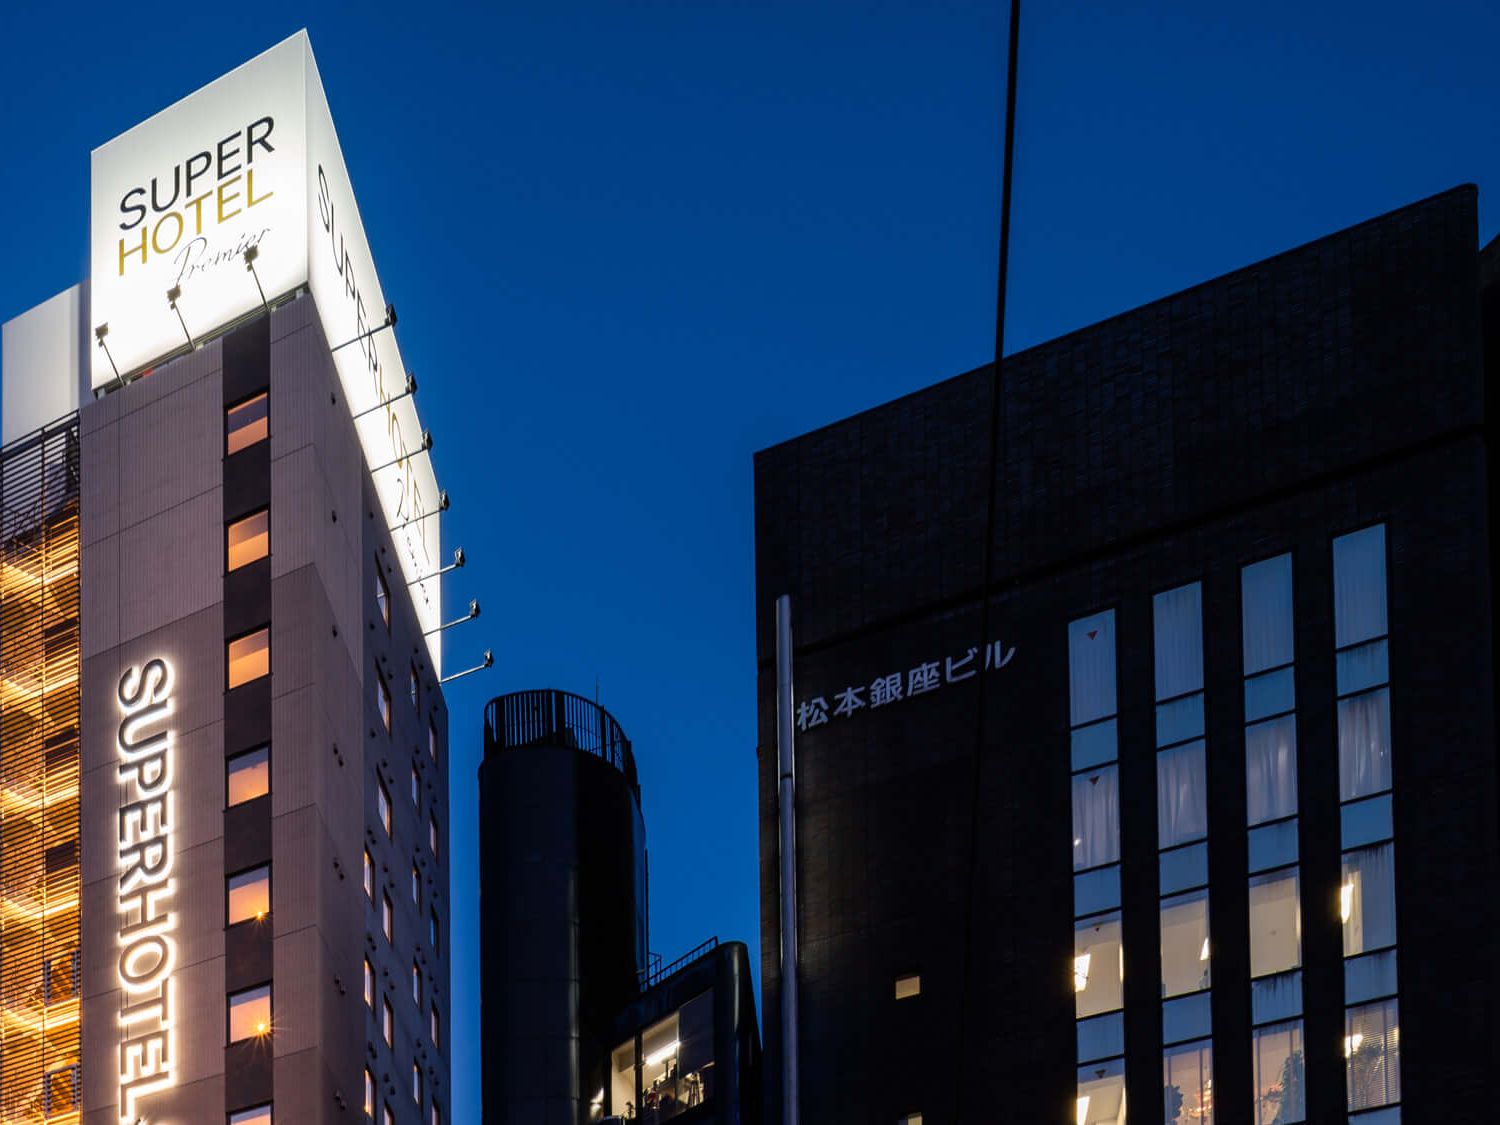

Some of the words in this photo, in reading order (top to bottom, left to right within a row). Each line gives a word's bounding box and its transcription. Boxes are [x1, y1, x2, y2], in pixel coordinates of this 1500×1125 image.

[118, 115, 276, 231] SUPER
[118, 168, 275, 277] HOTEL
[173, 227, 272, 286] Premier
[796, 639, 1017, 732] 松本銀座ビル
